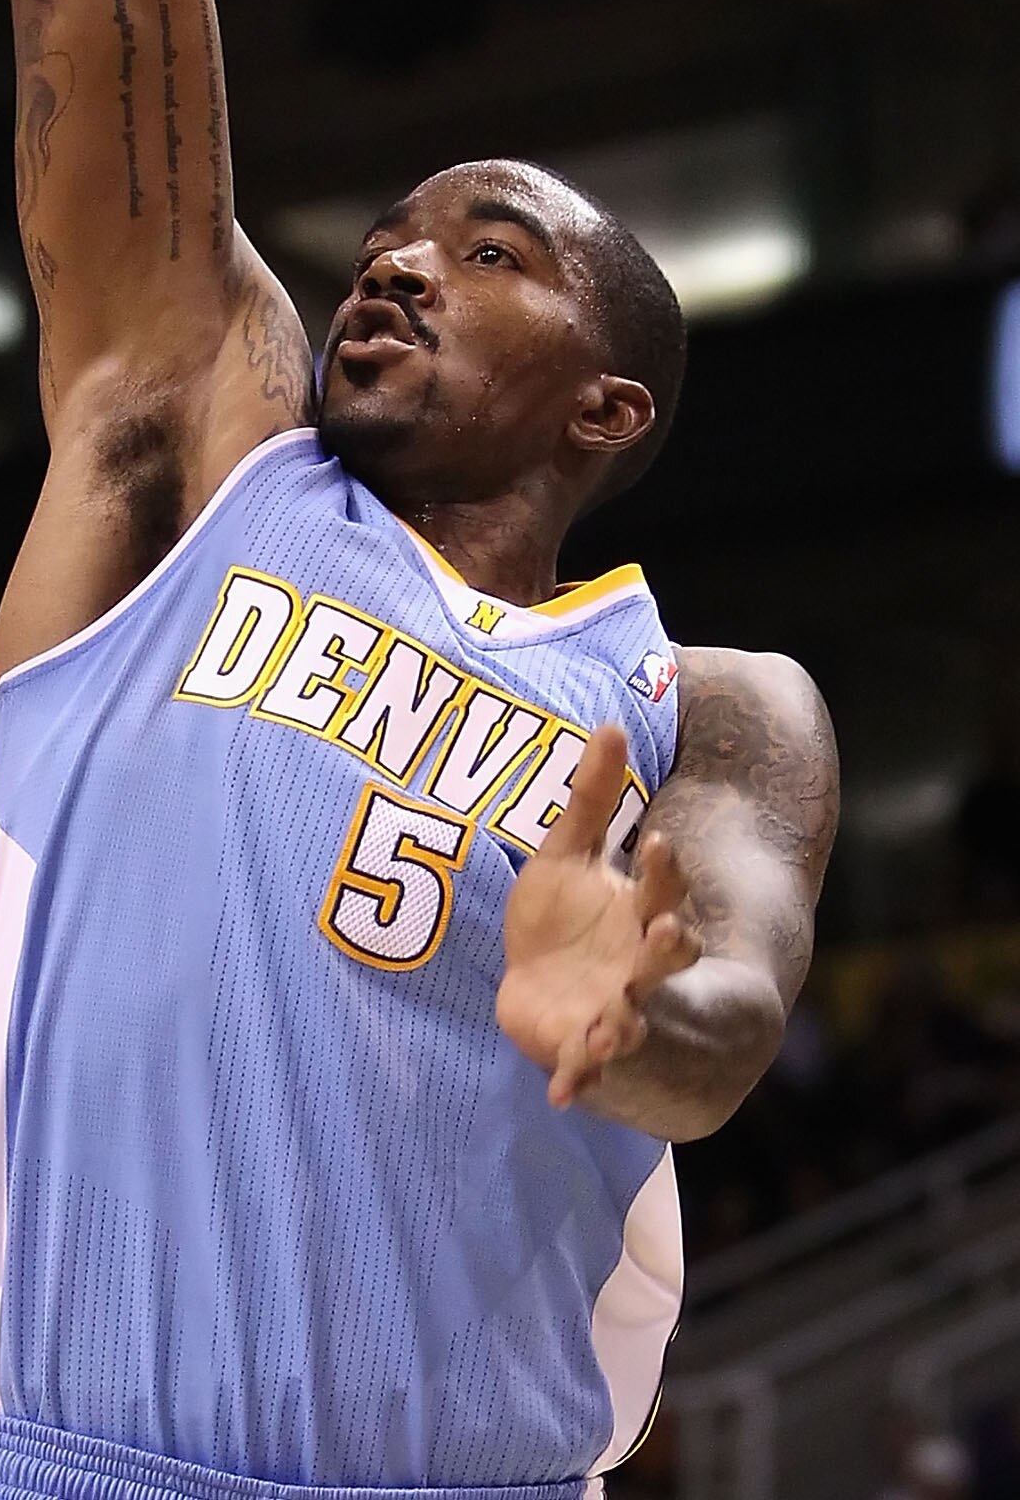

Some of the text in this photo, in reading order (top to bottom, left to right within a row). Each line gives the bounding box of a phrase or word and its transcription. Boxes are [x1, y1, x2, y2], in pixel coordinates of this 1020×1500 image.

[465, 601, 506, 635] N
[628, 674, 653, 697] NBA
[318, 780, 477, 973] 5
